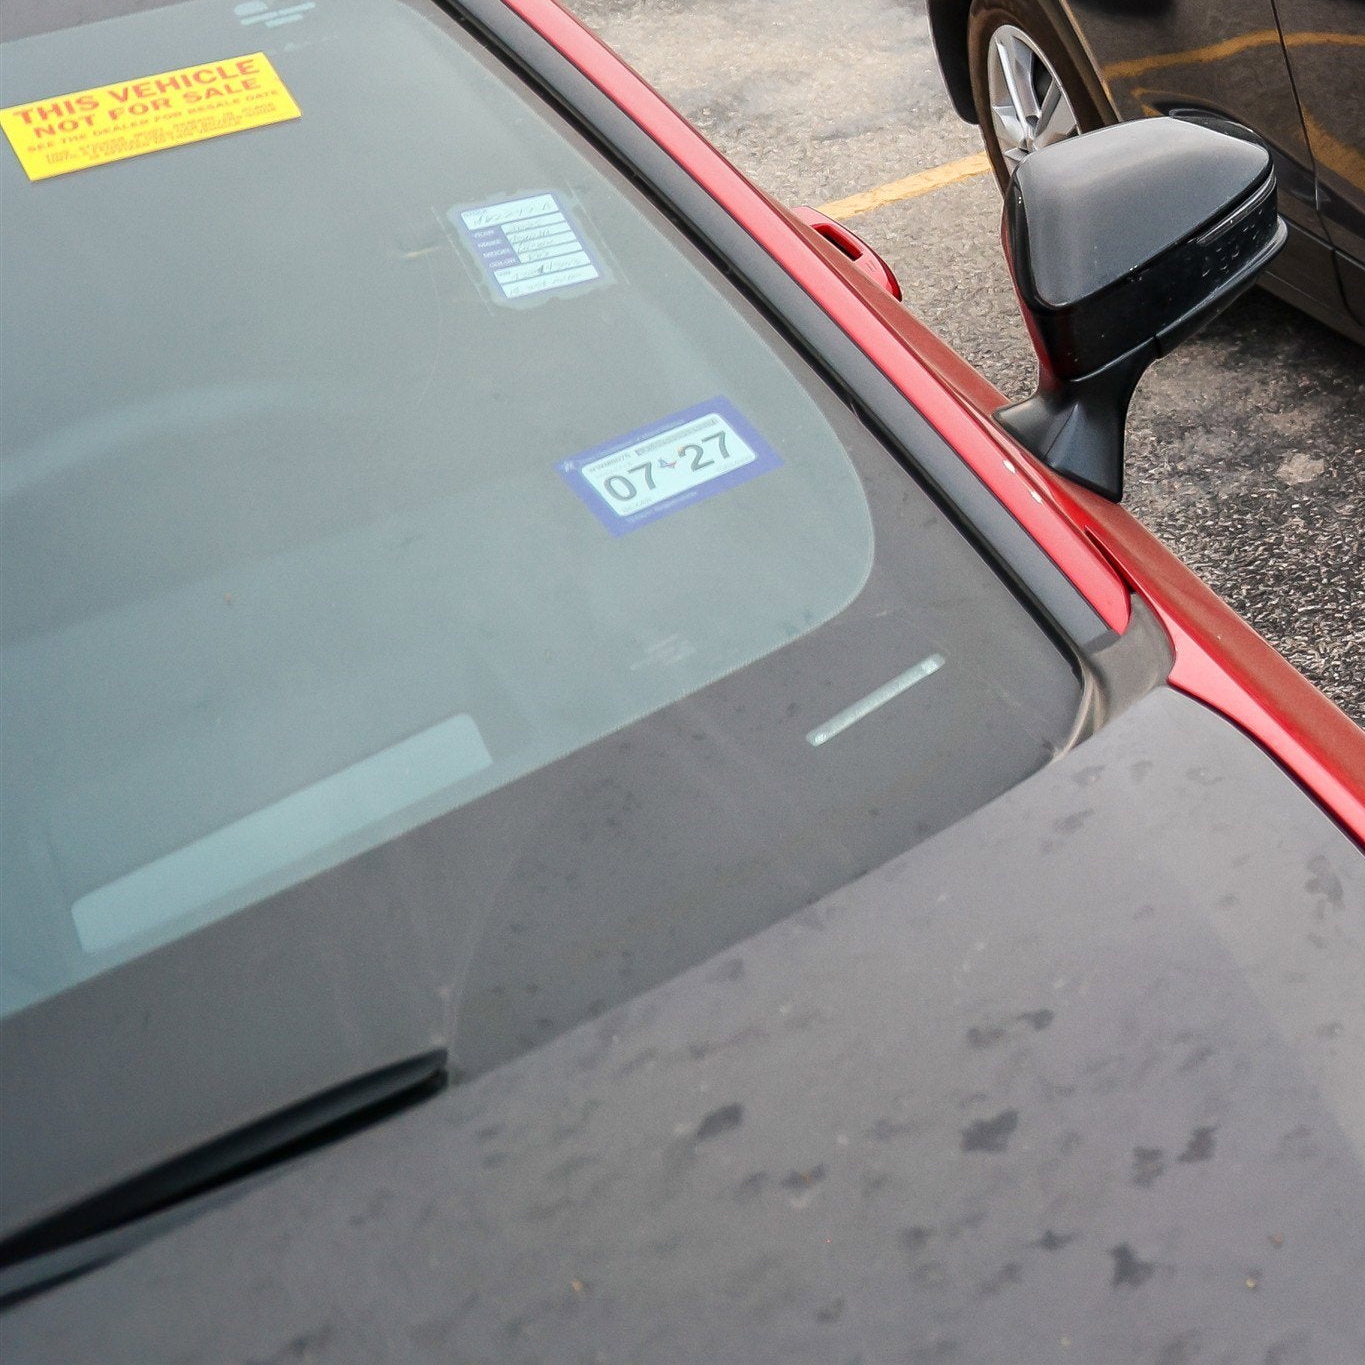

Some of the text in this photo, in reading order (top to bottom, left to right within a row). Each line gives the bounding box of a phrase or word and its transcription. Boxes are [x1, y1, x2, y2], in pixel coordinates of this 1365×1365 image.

[13, 59, 260, 125] THIS VEHICLE
[33, 78, 261, 138] NOT FOR SALE
[603, 462, 657, 503] 07
[678, 430, 731, 473] 27
